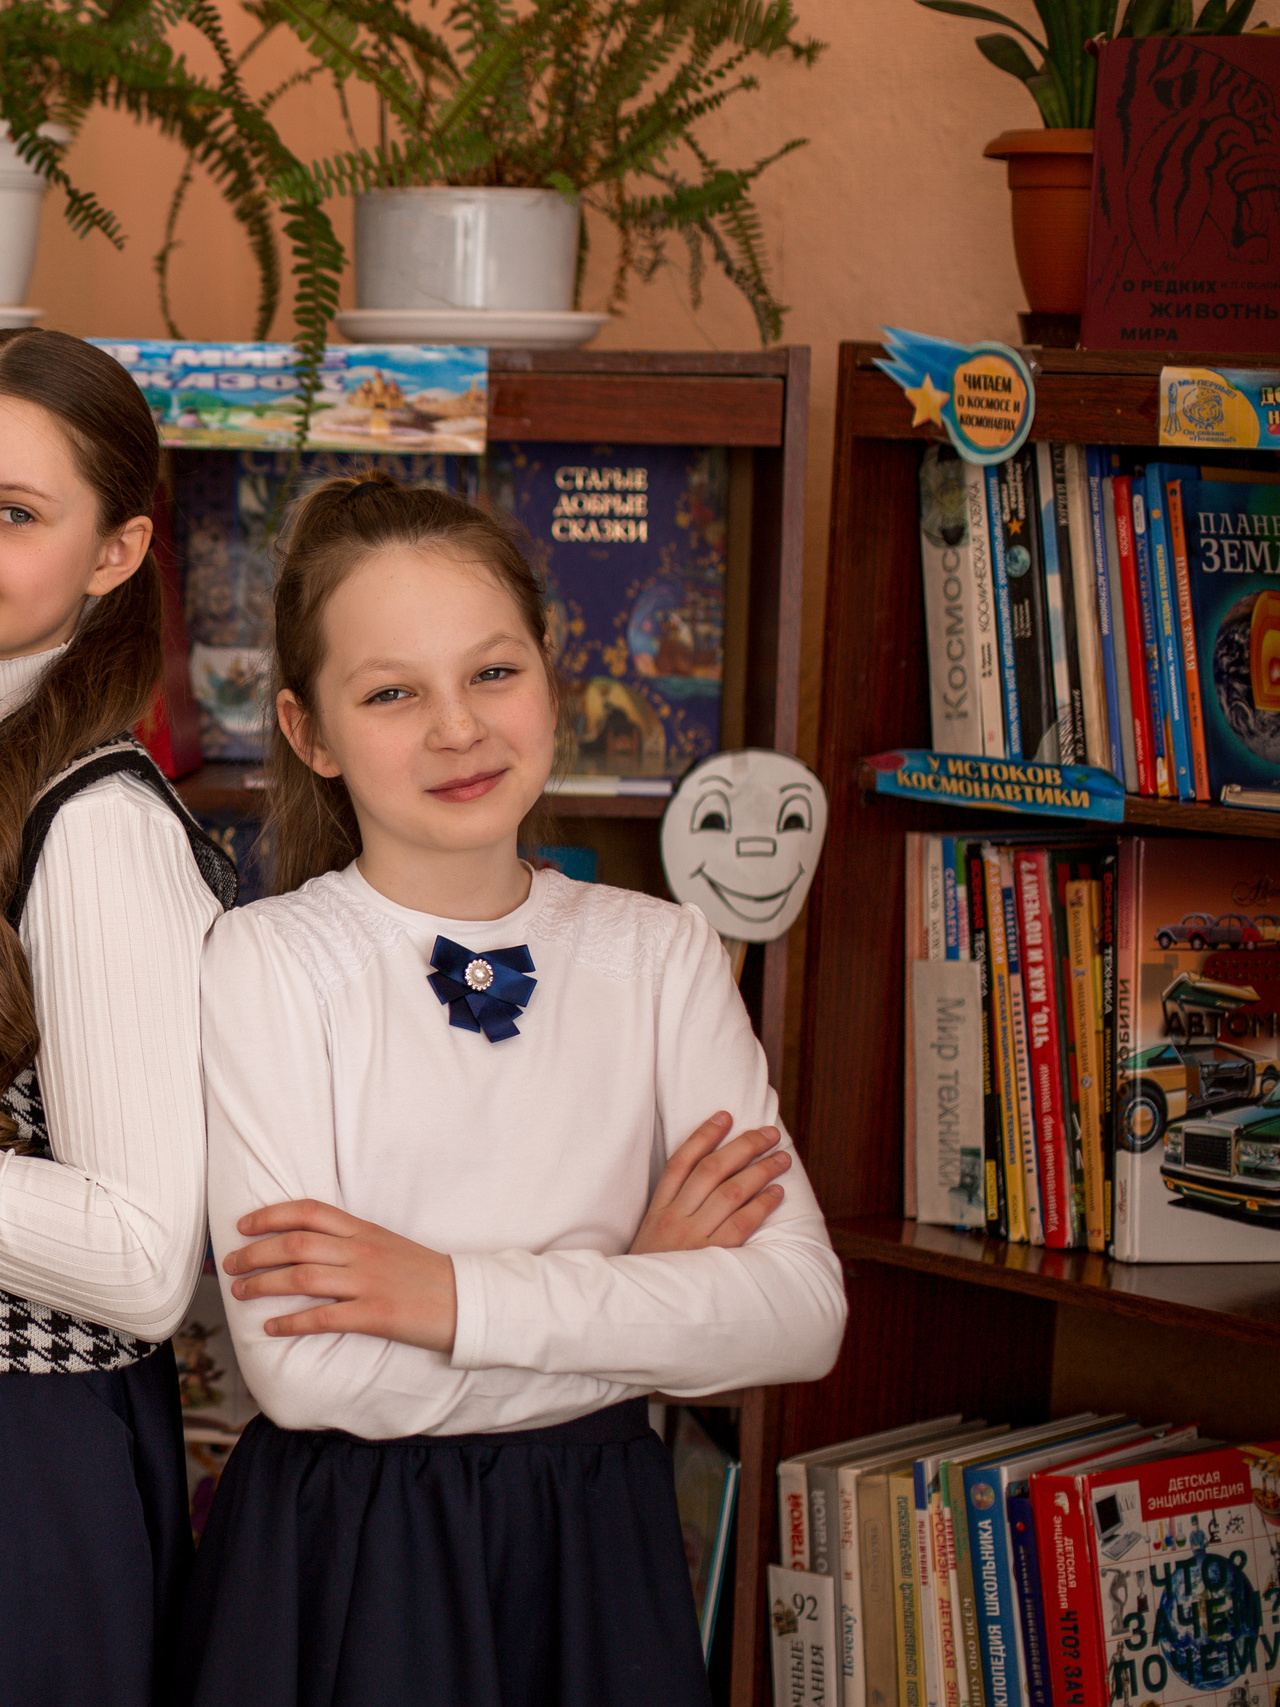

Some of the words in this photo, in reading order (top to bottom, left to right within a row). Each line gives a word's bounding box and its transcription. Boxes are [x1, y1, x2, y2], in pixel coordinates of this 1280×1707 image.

[1141, 279, 1217, 295] РЕДКИХ
[1120, 327, 1179, 342] МИРА
[962, 373, 1013, 393] ЧИТАЕМ
[966, 396, 1011, 412] КОСМОСЕ
[1178, 379, 1195, 387] МЫ
[1197, 379, 1238, 400] ПЕРВЫЕ!
[959, 415, 1018, 432] КОСМОНАВТАХ
[554, 466, 649, 493] СТАРЫЕ
[551, 517, 649, 544] СКАЗКИ
[553, 493, 649, 519] ДОБРЫЕ
[1136, 536, 1154, 640] АСТРОНОМИЯ
[1176, 556, 1190, 620] ПЛАНЕТА
[999, 587, 1015, 667] ЭНЦИКЛОПЕДИЯ
[1182, 623, 1196, 671] ЗЕМЛЯ
[896, 768, 1090, 809] КОСМОНАВТИКИ
[927, 756, 941, 773] У
[947, 757, 1062, 786] ИСТОКОВ
[944, 867, 957, 947] САМОЛЕТЫ
[970, 858, 984, 929] ВОЕННАЯ
[988, 865, 1006, 965] АВТОМОБИЛИ
[1021, 860, 1043, 946] ПОЧЕМУ?
[1103, 872, 1114, 943] ВОЕННАЯ
[1026, 947, 1045, 962] И
[1103, 944, 1114, 1015] ТЕХНИКА
[996, 972, 1008, 1022] ДЕТСКАЯ
[1027, 965, 1048, 1004] КАК
[929, 997, 967, 1062] Мир
[1030, 1005, 1051, 1049] ЧТО,
[1077, 976, 1090, 1073] ЭНЦИКЛОПЕДИЯ
[1000, 1024, 1014, 1112] ЭНЦИКЛОПЕДИЯ
[1038, 1063, 1053, 1113] техники
[1104, 1026, 1113, 1112] ЭНЦИКЛОПЕДИЯ
[936, 1069, 961, 1189] техники
[1006, 1113, 1017, 1165] ТЕХНИКИ
[1042, 1113, 1056, 1142] мир
[1043, 1142, 1060, 1233] Удивительный
[1147, 1481, 1246, 1512] ЭНЦИКЛОПЕДИЯ
[1168, 1470, 1221, 1494] ДЕТСКАЯ
[787, 1492, 805, 1559] такой
[810, 1489, 828, 1558] такой
[839, 1488, 854, 1550] Зачем?
[977, 1518, 1001, 1617] ШКОЛЬНИКА
[1053, 1514, 1069, 1610] ЭНЦИКЛОПЕДИЯ
[1063, 1536, 1077, 1589] ДЕТСКАЯ
[1150, 1549, 1248, 1600] ЧТО?
[791, 1592, 818, 1622] 92
[939, 1597, 955, 1669] ДЕТСКАЯ
[962, 1596, 976, 1638] ВСЁМ
[1123, 1586, 1280, 1653] ЗАЧЕМ?
[842, 1603, 857, 1678] Почему?
[967, 1639, 979, 1671] ОБО
[1059, 1610, 1081, 1661] ЧТО?
[789, 1638, 805, 1707] ЧНЫЕ
[1063, 1664, 1085, 1706] ЗАЧ
[1112, 1630, 1280, 1700] ПОЧЕМУ
